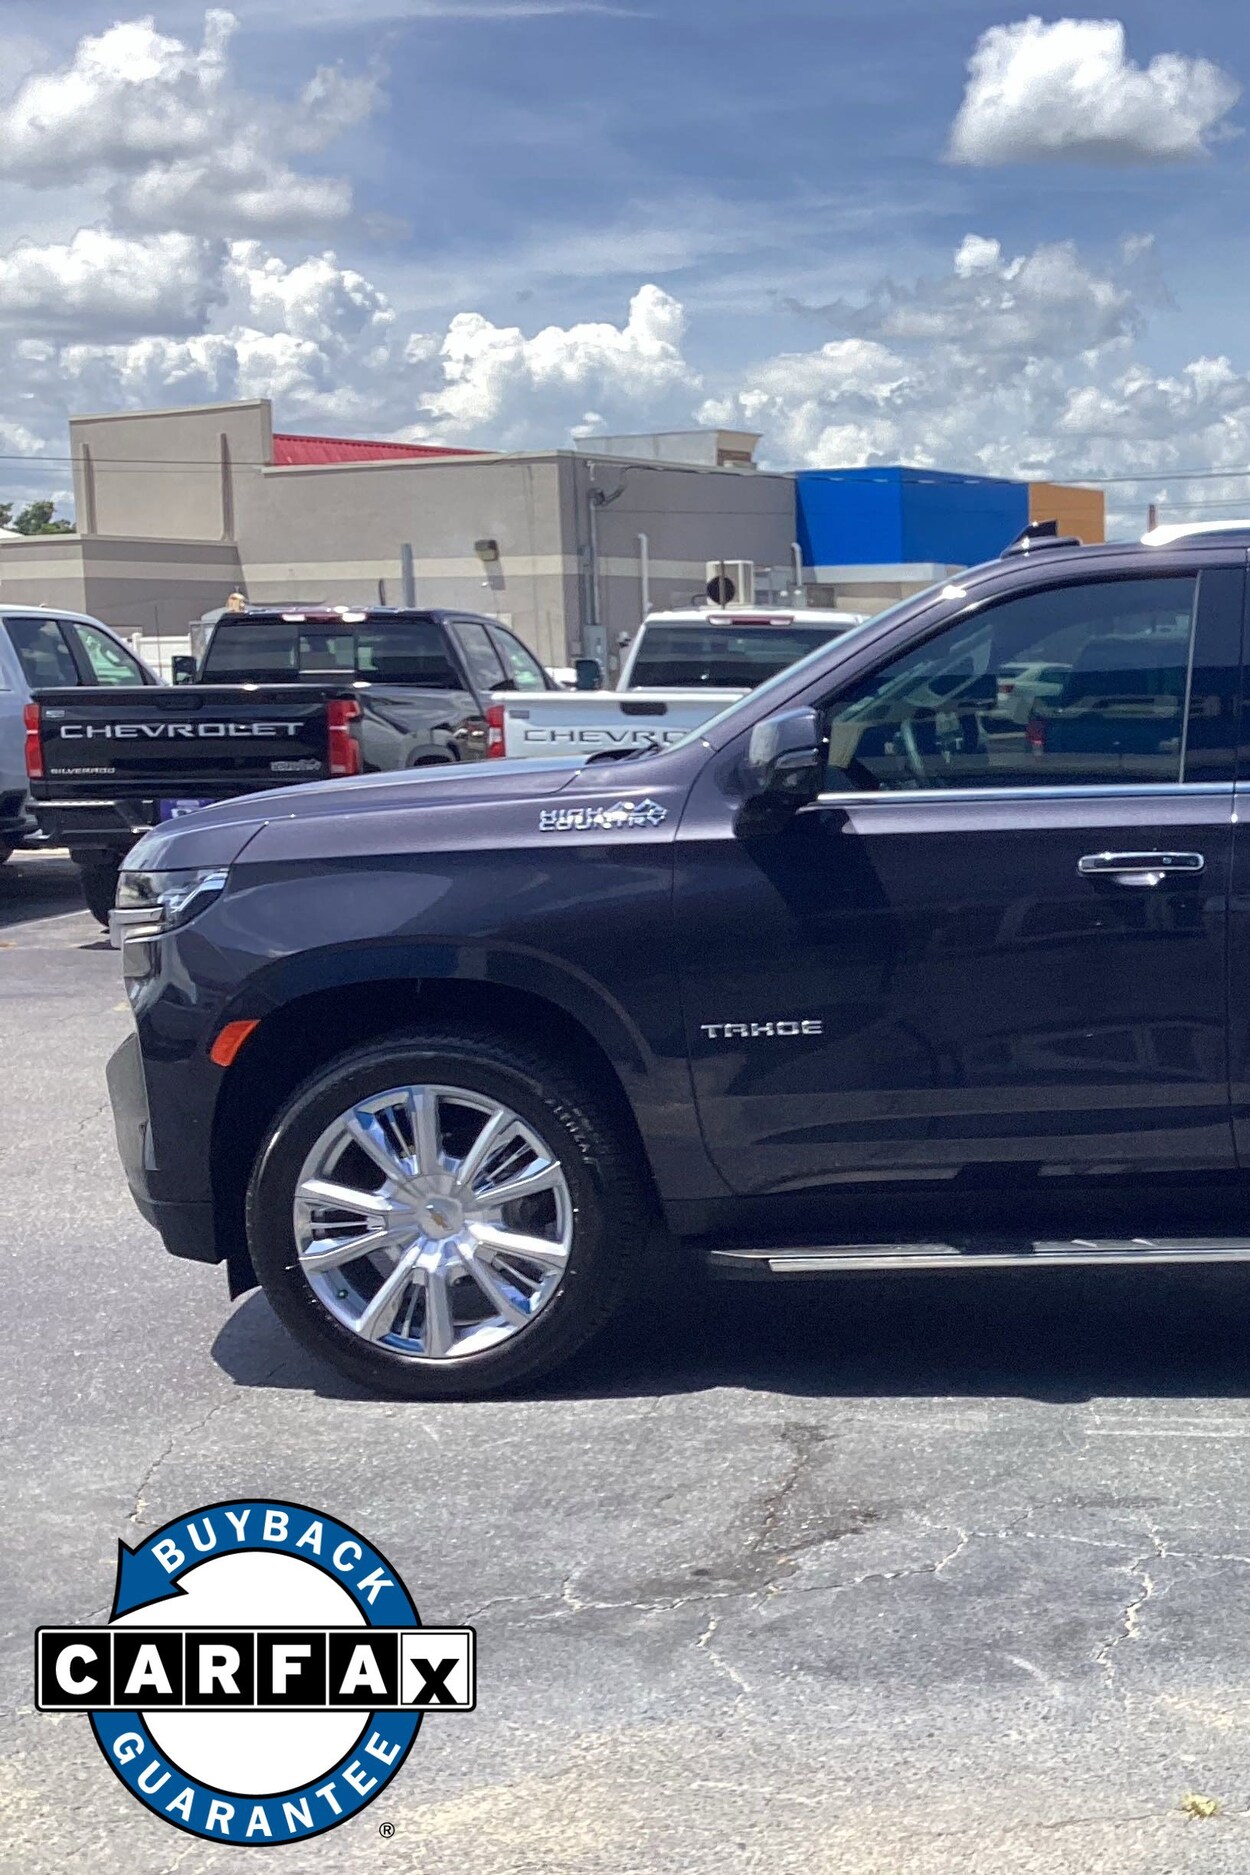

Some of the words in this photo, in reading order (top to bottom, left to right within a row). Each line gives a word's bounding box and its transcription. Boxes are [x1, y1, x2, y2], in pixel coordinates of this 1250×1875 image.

[60, 721, 304, 739] CHEVROLET
[524, 729, 690, 745] CHEVRO
[50, 767, 116, 775] SILVERADO
[700, 1020, 823, 1039] TAHOE
